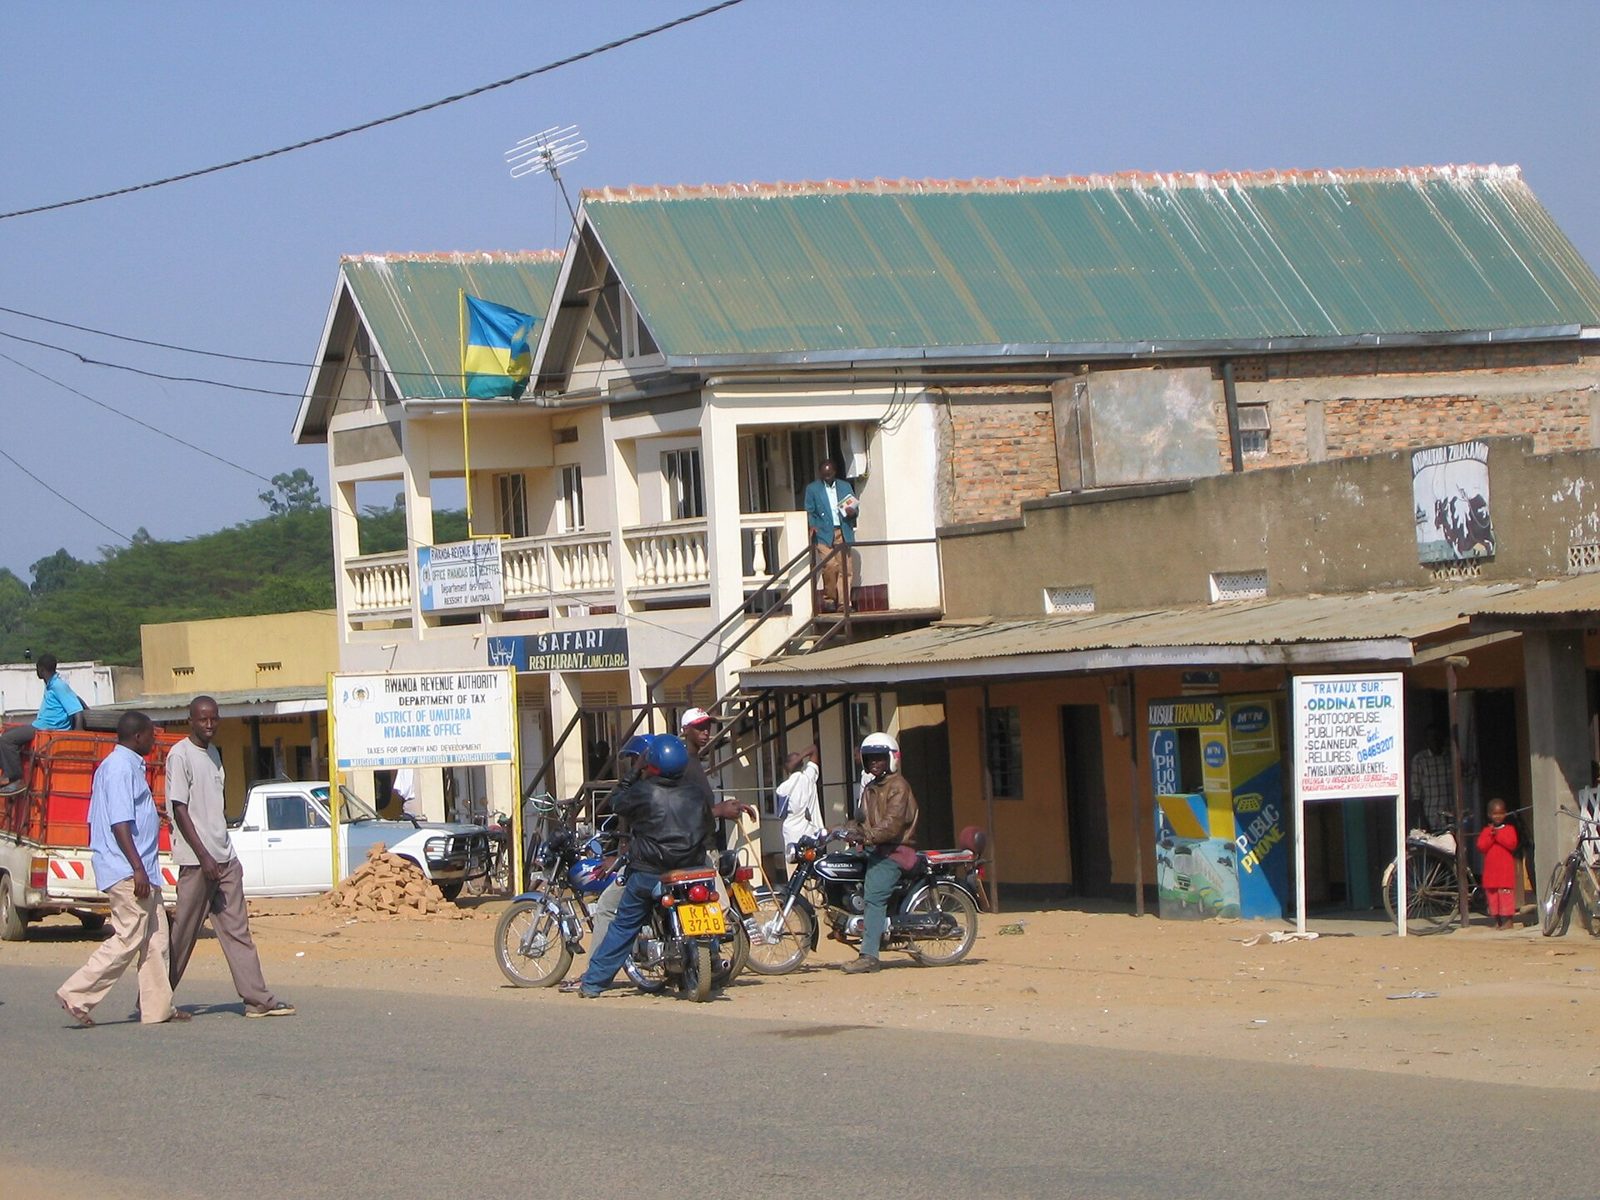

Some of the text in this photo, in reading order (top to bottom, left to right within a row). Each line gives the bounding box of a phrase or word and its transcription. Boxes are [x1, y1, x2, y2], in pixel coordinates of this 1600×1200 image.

[538, 630, 603, 652] SAFARI
[385, 674, 498, 693] RWANDA REVENUE AUTHORITY
[1313, 682, 1357, 694] TRAVAUX
[399, 694, 486, 706] DEPARTMENT OF TAX
[375, 708, 472, 724] DISTRICT OF UMUTARA
[1149, 703, 1214, 725] KIOSQUE TERMINUS
[1238, 712, 1264, 723] MTN
[384, 722, 462, 738] NYAGATARE OFFICE
[1308, 726, 1334, 738] PUBLI
[387, 746, 398, 754] FOR
[400, 745, 424, 753] GROWTH
[426, 744, 438, 752] AND
[440, 744, 482, 752] DEVELOPMENT
[1236, 804, 1280, 854] PUBLIC
[1241, 823, 1285, 874] PHONE
[689, 918, 720, 932] 371B
